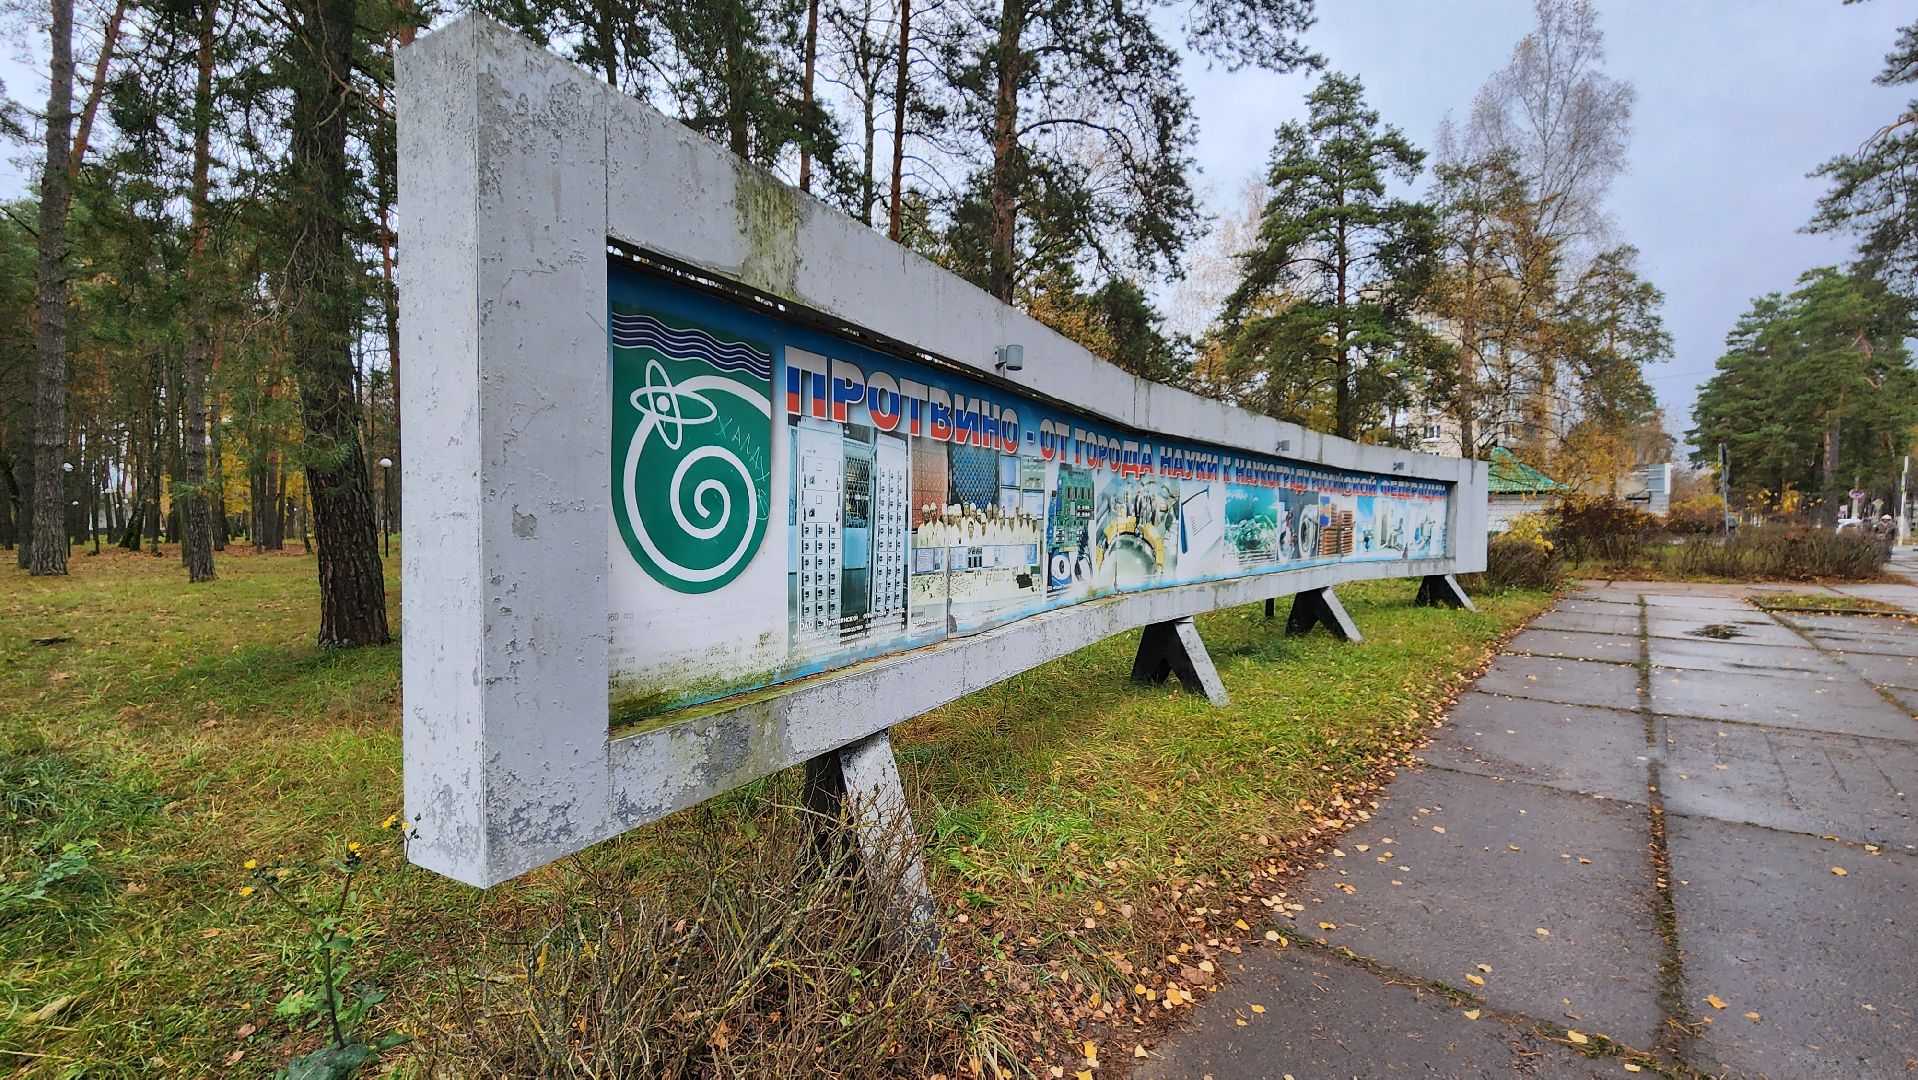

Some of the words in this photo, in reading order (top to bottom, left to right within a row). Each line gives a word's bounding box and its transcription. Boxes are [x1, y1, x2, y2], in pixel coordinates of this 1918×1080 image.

[784, 344, 1020, 454] ПРОТВИНО
[1039, 417, 1070, 463] ОТ
[1074, 428, 1155, 481] ГОРОДА
[1159, 444, 1219, 482] НАУКИ
[1223, 456, 1232, 484] К
[1235, 458, 1310, 495] НАУКОГРАДУ
[1310, 468, 1377, 498] РОССИЙСКОЙ
[1380, 479, 1448, 502] ФЕДЕРАЦИИ
